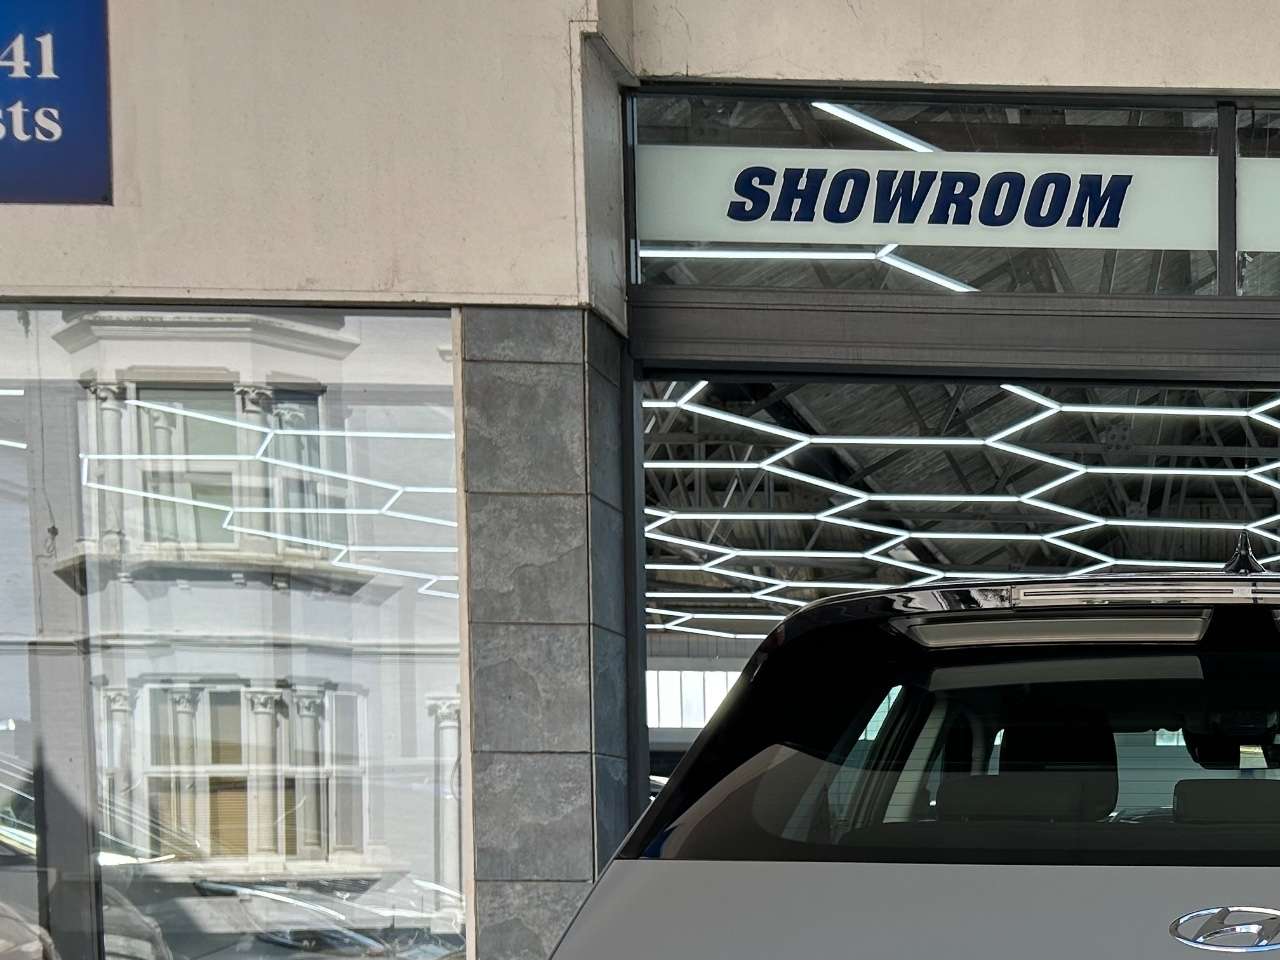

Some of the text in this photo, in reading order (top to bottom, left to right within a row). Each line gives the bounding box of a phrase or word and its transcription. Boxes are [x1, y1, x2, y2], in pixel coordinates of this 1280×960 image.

[0, 32, 61, 79] 41
[0, 100, 63, 142] ts
[726, 166, 1134, 228] SHOWROOM
